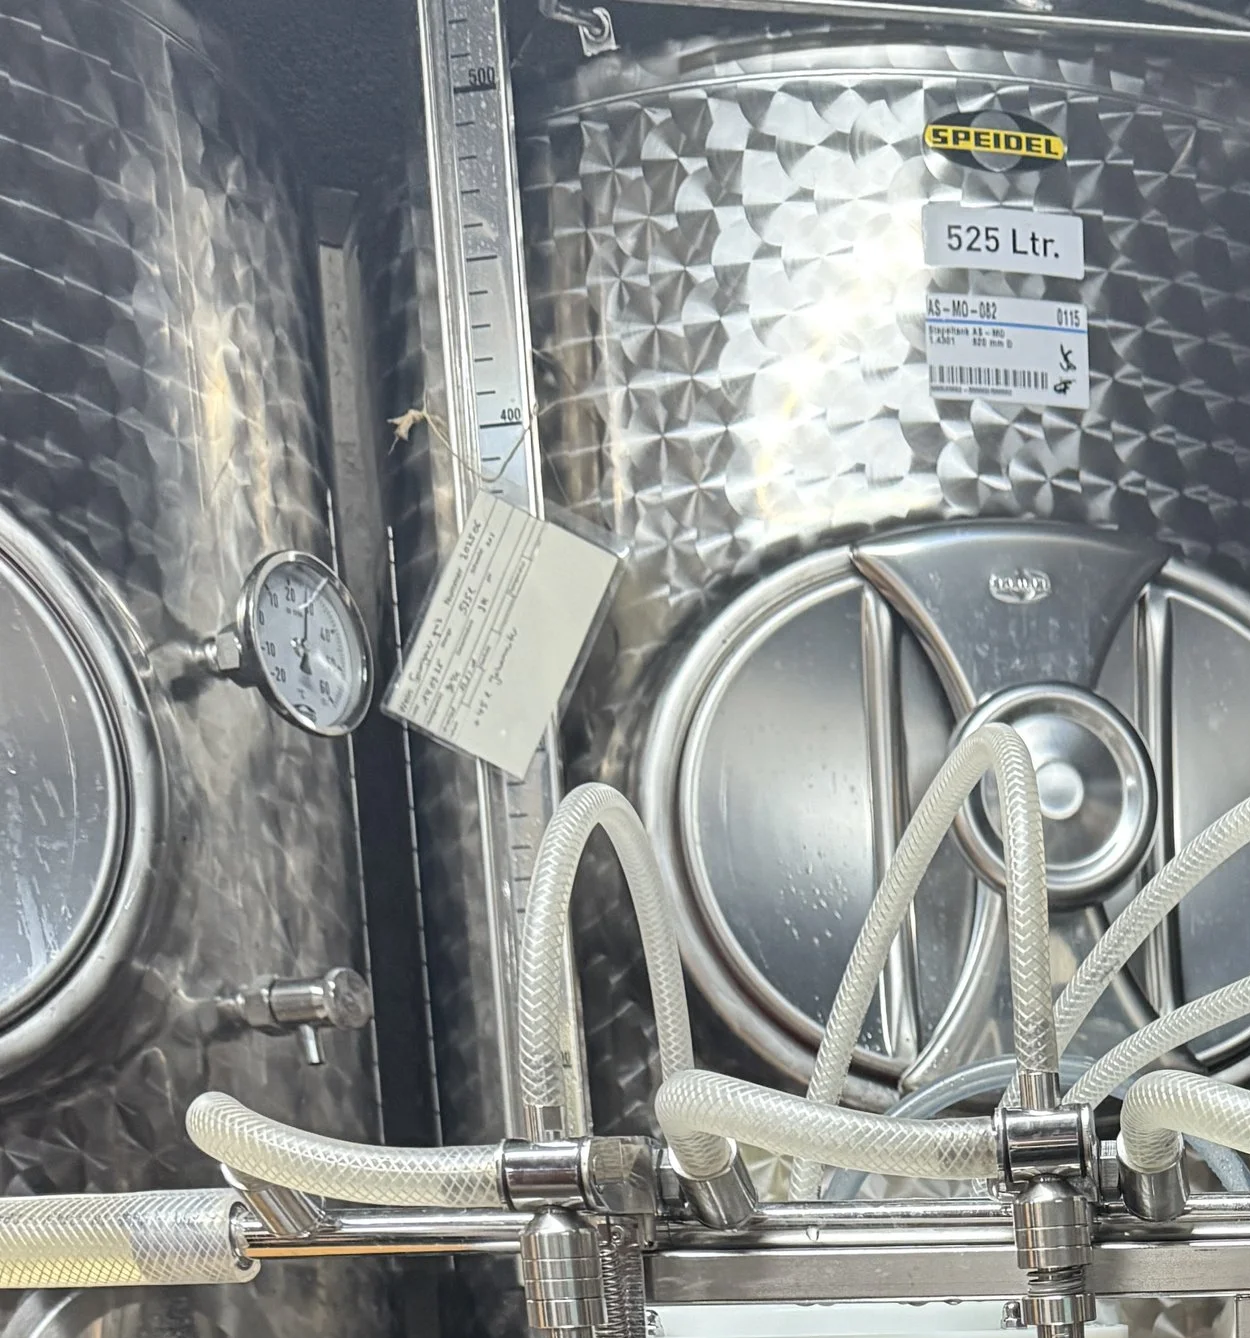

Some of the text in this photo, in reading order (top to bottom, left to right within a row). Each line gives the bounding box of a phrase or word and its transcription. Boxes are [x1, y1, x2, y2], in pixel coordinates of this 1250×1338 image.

[469, 67, 495, 86] 500
[932, 128, 1059, 156] SPEIDEL
[947, 225, 1060, 259] 525 Ltr.
[1056, 308, 1081, 328] 0115
[500, 408, 521, 422] 400
[285, 586, 296, 602] 20
